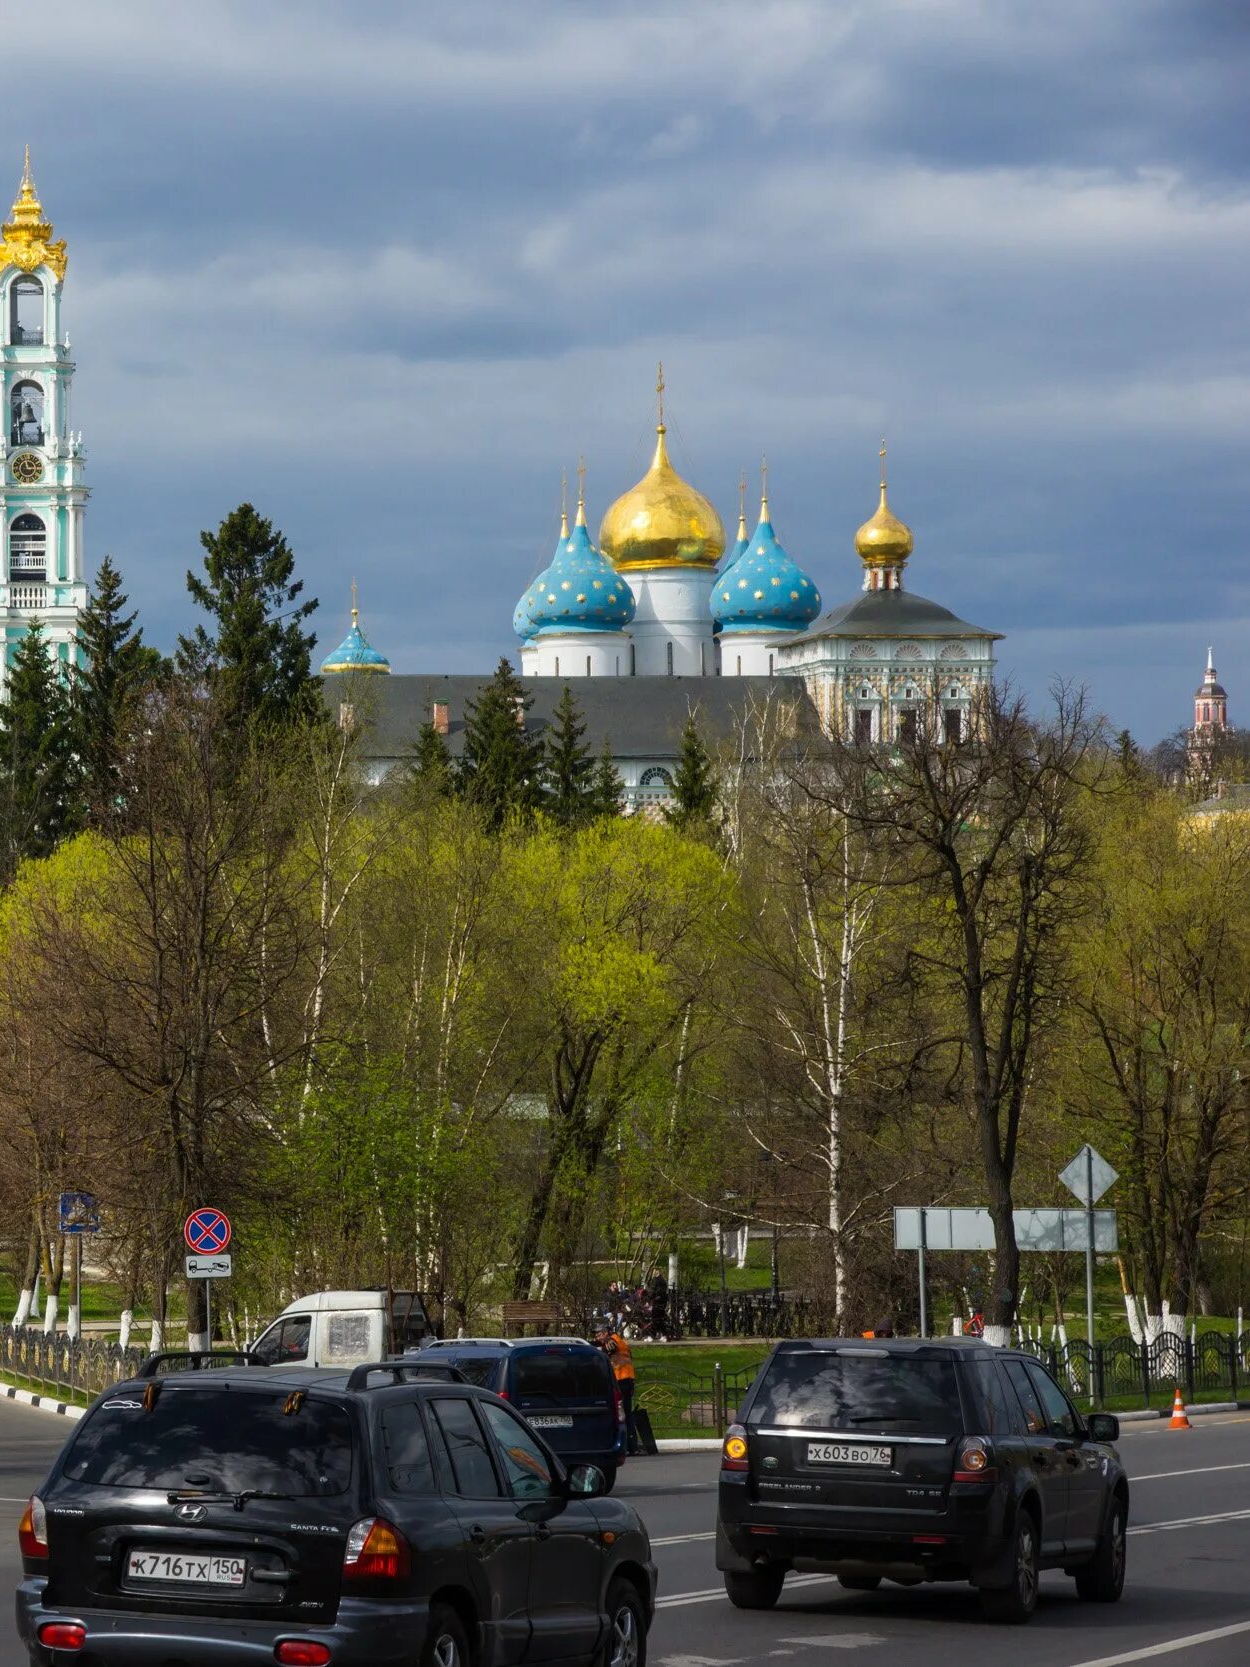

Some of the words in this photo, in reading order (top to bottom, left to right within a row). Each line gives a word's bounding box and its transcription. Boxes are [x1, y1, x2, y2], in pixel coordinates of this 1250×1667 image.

[813, 1446, 869, 1462] Х603ВО
[872, 1447, 886, 1459] 76
[758, 1482, 812, 1491] FREELANDER
[290, 1523, 319, 1532] SANTA
[135, 1556, 208, 1579] К716ТХ
[212, 1559, 240, 1575] 150
